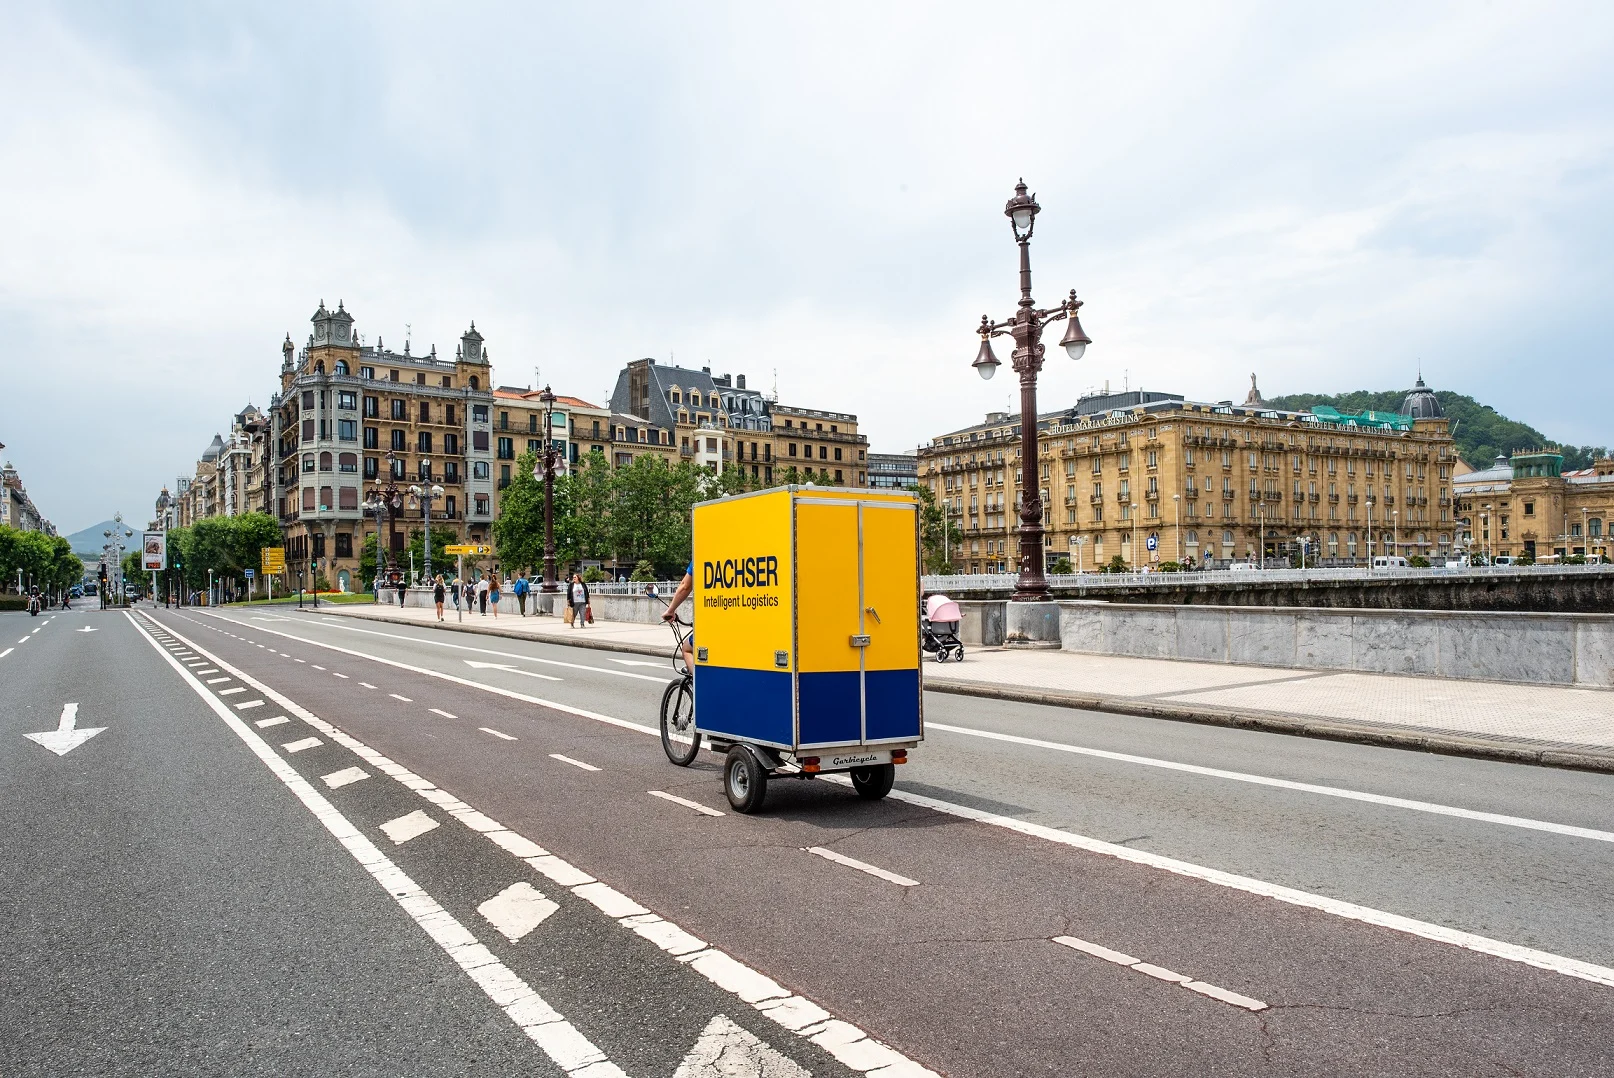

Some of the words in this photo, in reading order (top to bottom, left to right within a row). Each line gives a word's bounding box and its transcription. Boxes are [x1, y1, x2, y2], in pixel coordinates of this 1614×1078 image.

[1051, 423, 1075, 434] HOTEL
[1076, 420, 1101, 431] MARIA
[1103, 413, 1139, 426] CRISTINA
[1309, 421, 1332, 430] HOTEL
[1336, 423, 1358, 432] MARIA
[1361, 425, 1393, 434] CRISTINA
[704, 556, 778, 589] DACHSER
[704, 595, 740, 610] Intelligent
[742, 594, 779, 610] Logistics
[832, 754, 877, 765] Garbicycle
